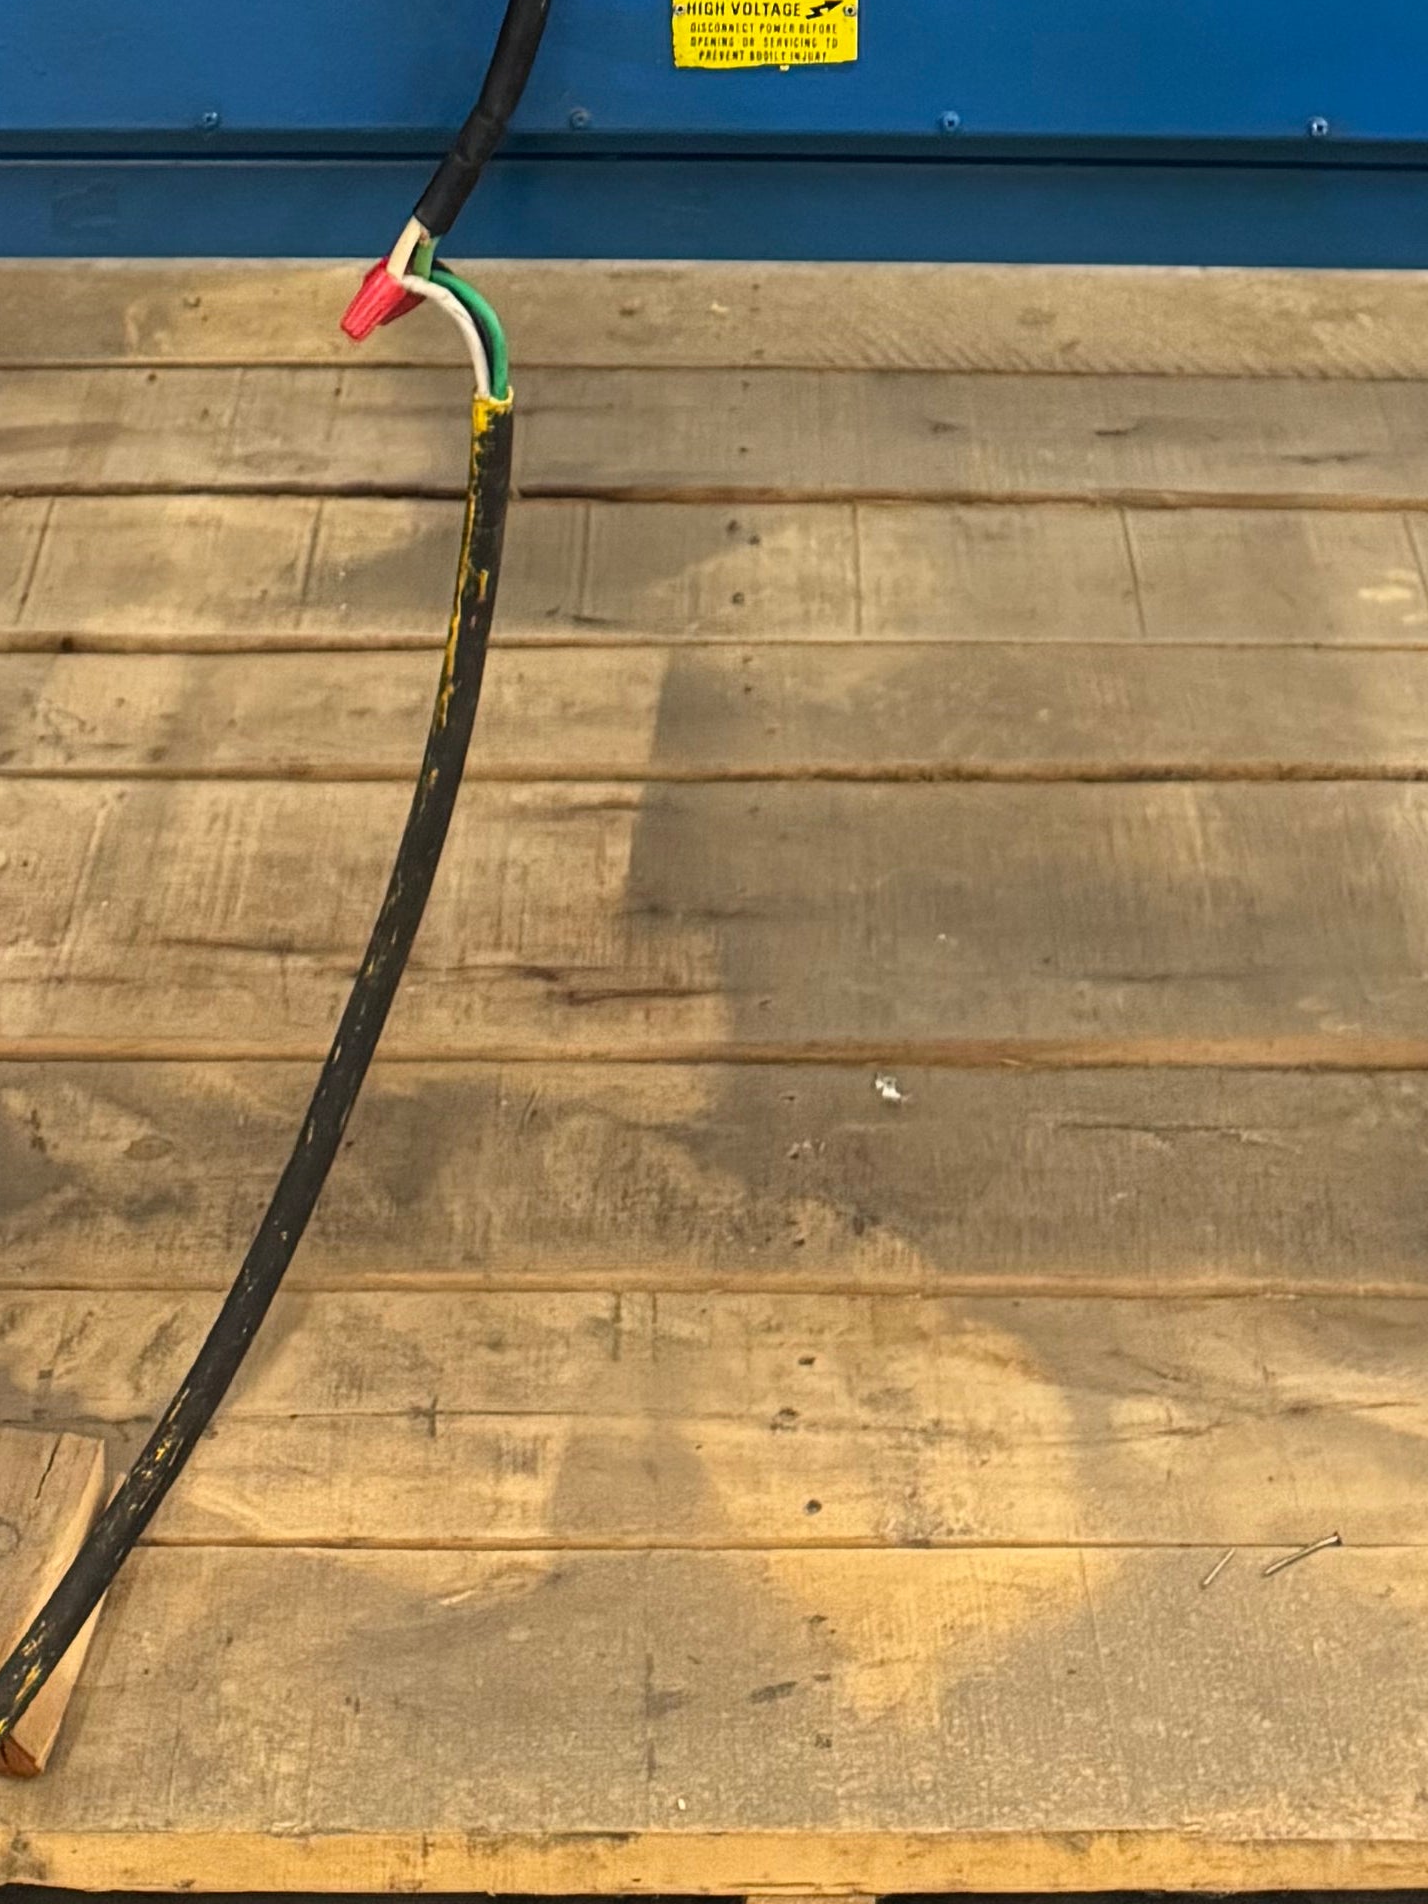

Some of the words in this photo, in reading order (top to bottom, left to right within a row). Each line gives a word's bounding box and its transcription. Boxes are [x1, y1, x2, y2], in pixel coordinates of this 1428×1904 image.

[686, 1, 725, 16] HIGH
[731, 2, 801, 17] VOLTAGE
[690, 22, 754, 33] DISCONNECT
[759, 23, 794, 33] POWER
[799, 23, 837, 34] BEFORE
[690, 36, 734, 47] OPENING
[742, 37, 755, 47] OR
[763, 36, 817, 48] SERVICING
[826, 37, 838, 48] TO
[699, 49, 744, 61] PREVENT
[750, 51, 786, 62] BODILY
[790, 51, 827, 63] INJURY
